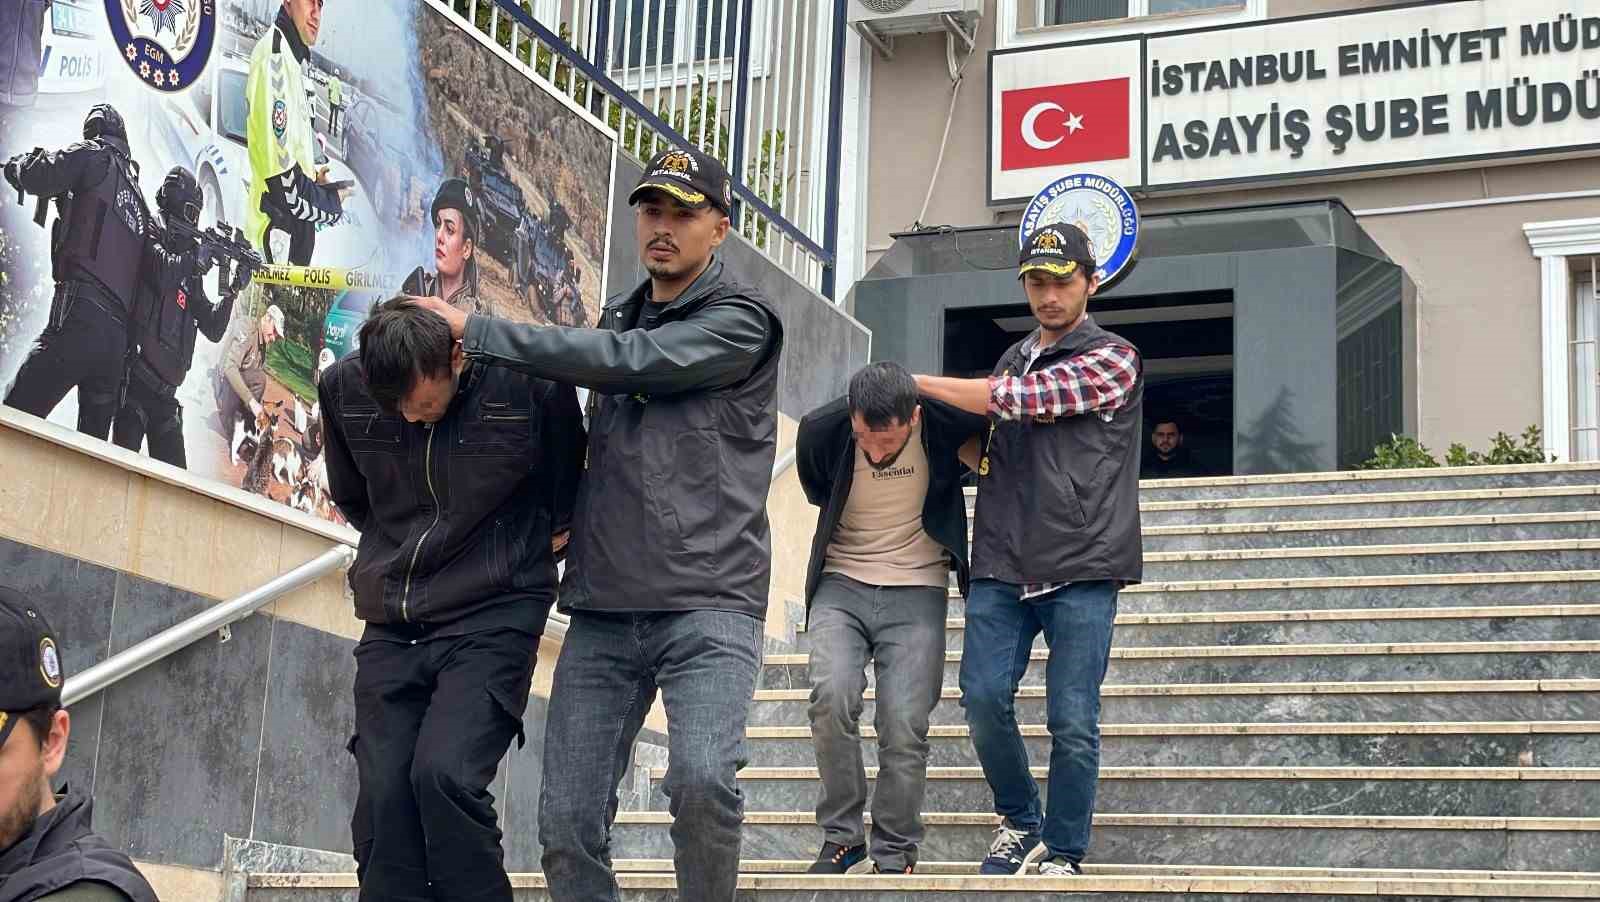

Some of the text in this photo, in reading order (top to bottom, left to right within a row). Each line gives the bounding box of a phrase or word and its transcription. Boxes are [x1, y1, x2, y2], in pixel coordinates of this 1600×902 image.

[59, 54, 93, 78] POLİS
[144, 44, 165, 64] EGM
[1151, 49, 1327, 97] İSTANBUL
[1338, 27, 1507, 77] EMNİYET
[1152, 102, 1311, 163] ASAYİŞ
[1325, 94, 1449, 156] ŞUBE
[1024, 196, 1048, 237] ASAYİŞ
[1048, 178, 1081, 198] ŞUBE
[1085, 178, 1134, 236] MÜDÜRLÜĞÜ
[303, 268, 331, 285] POLİS
